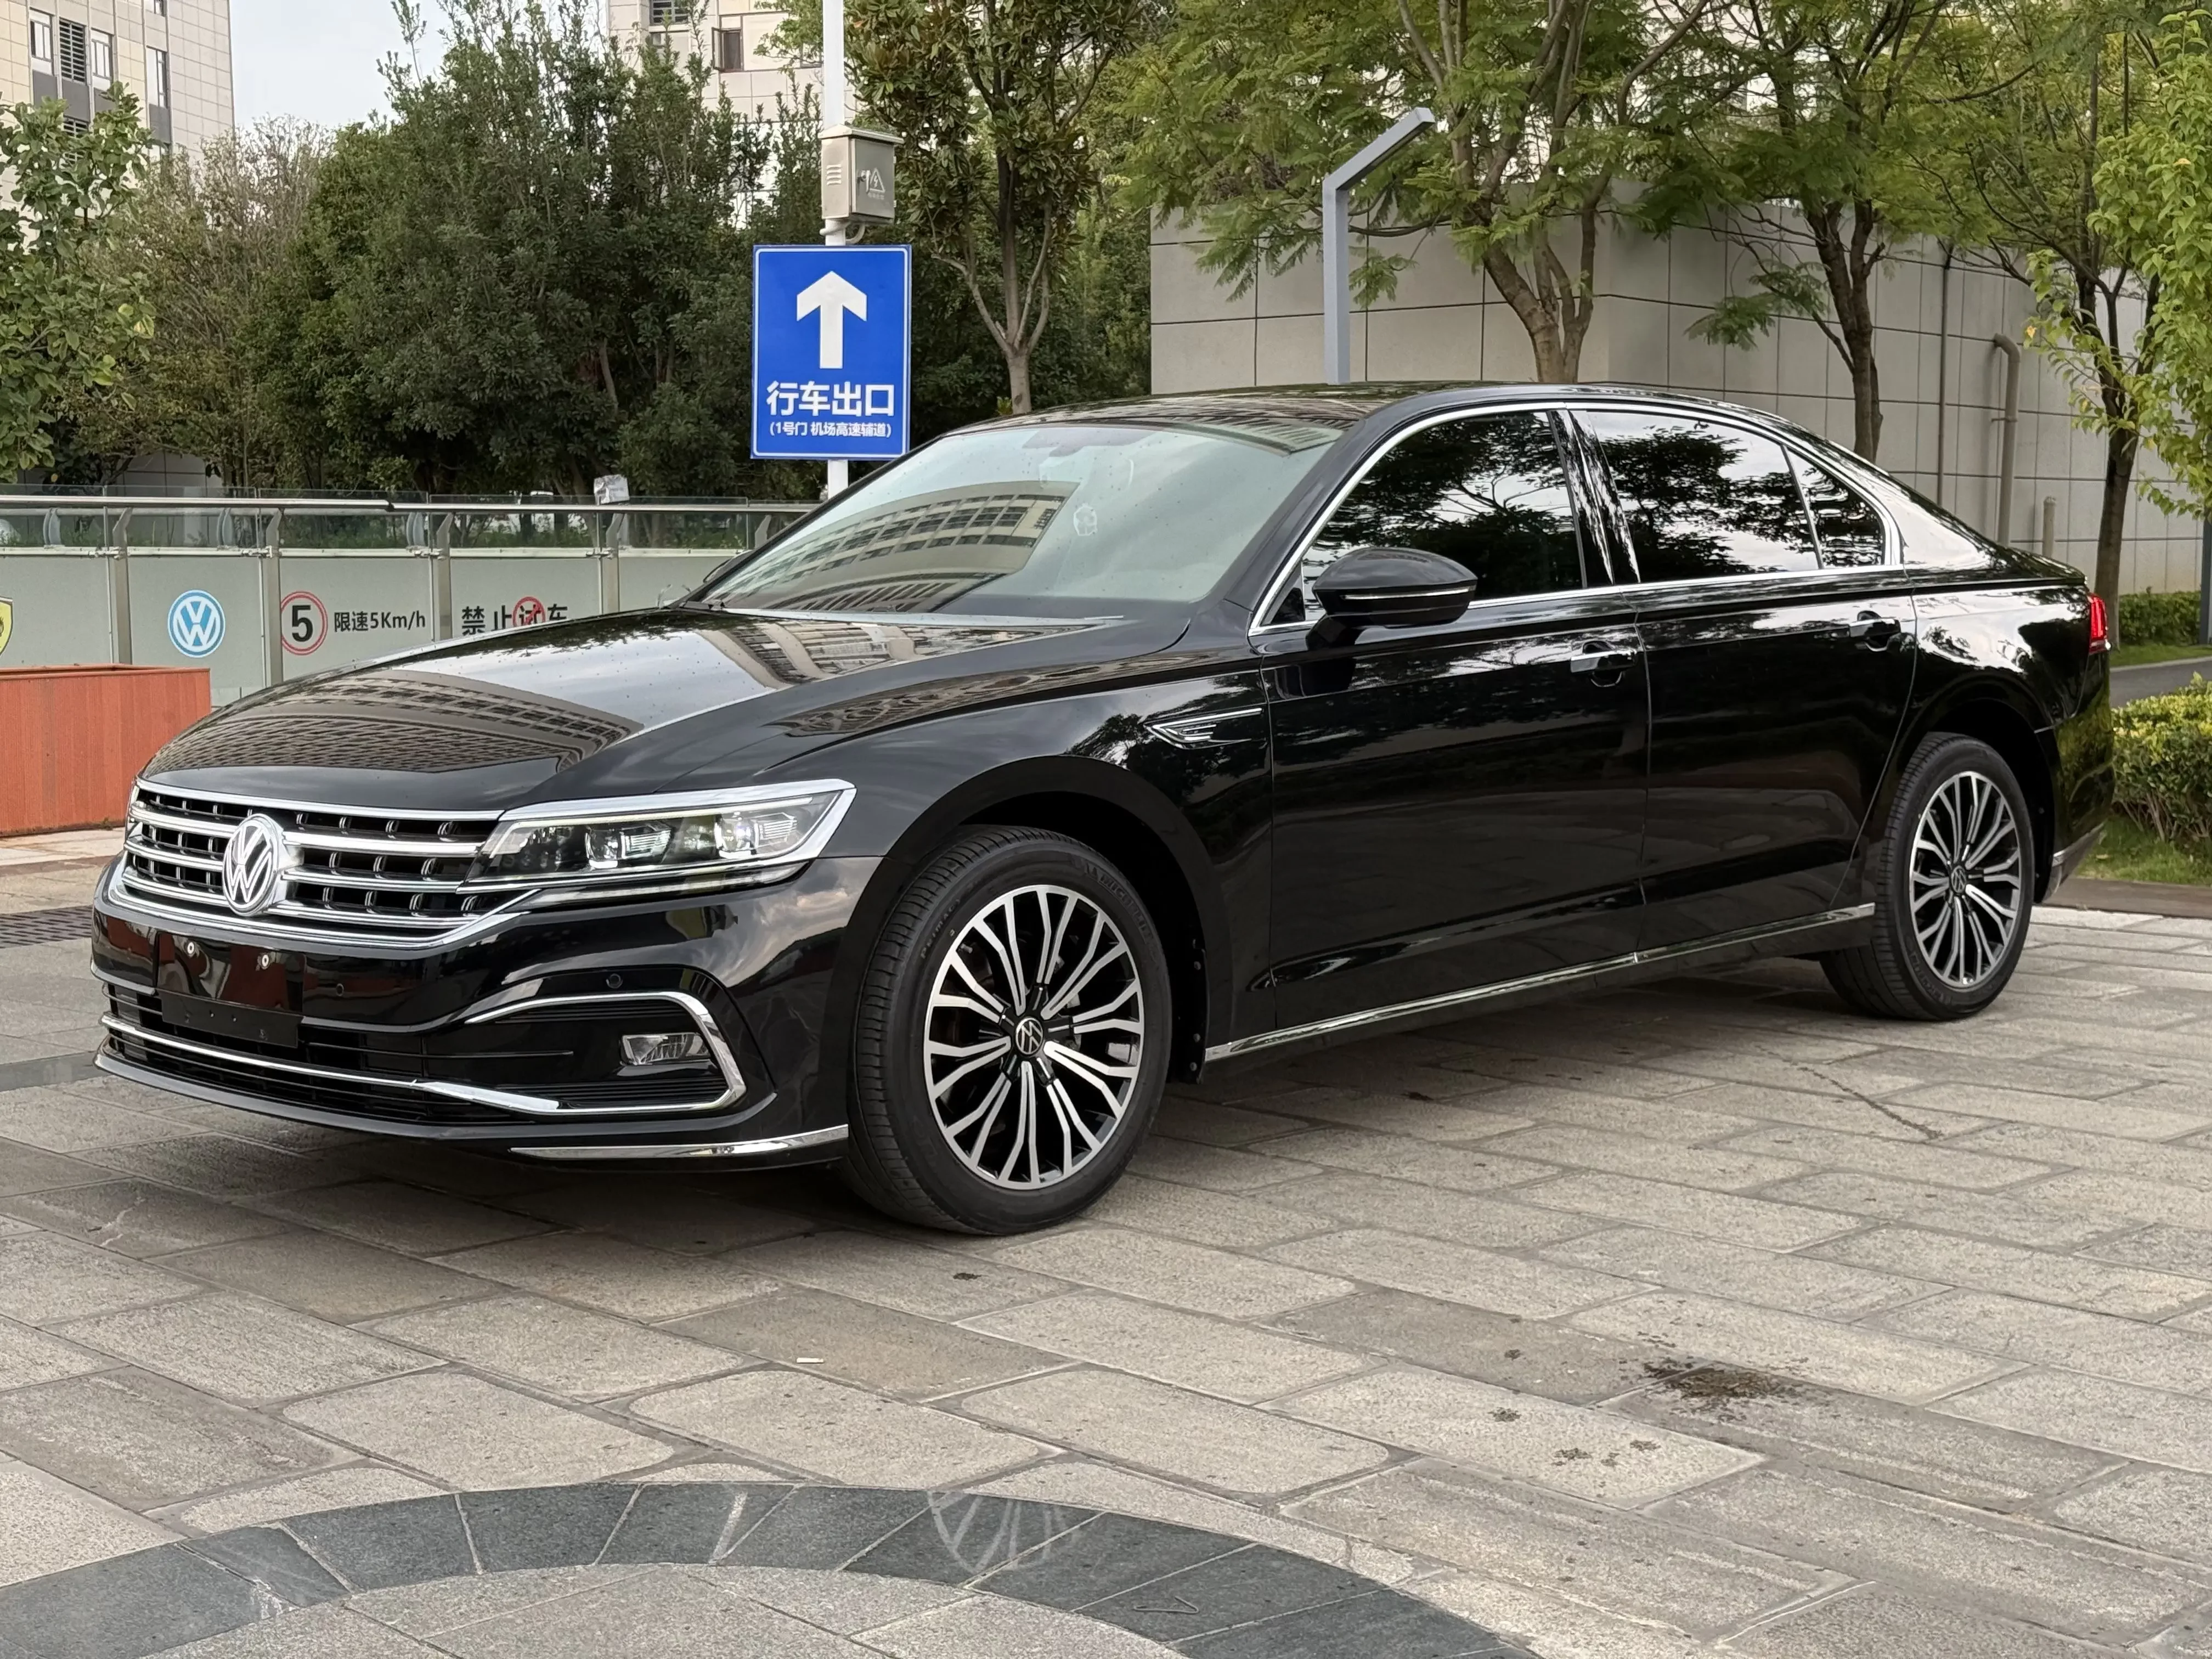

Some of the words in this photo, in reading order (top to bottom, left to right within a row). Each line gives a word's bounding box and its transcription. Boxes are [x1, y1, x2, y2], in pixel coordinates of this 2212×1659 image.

[766, 381, 895, 417] 行车出口
[770, 422, 808, 436] (1号门
[292, 605, 313, 642] 5
[334, 610, 426, 633] 限速5Km/h
